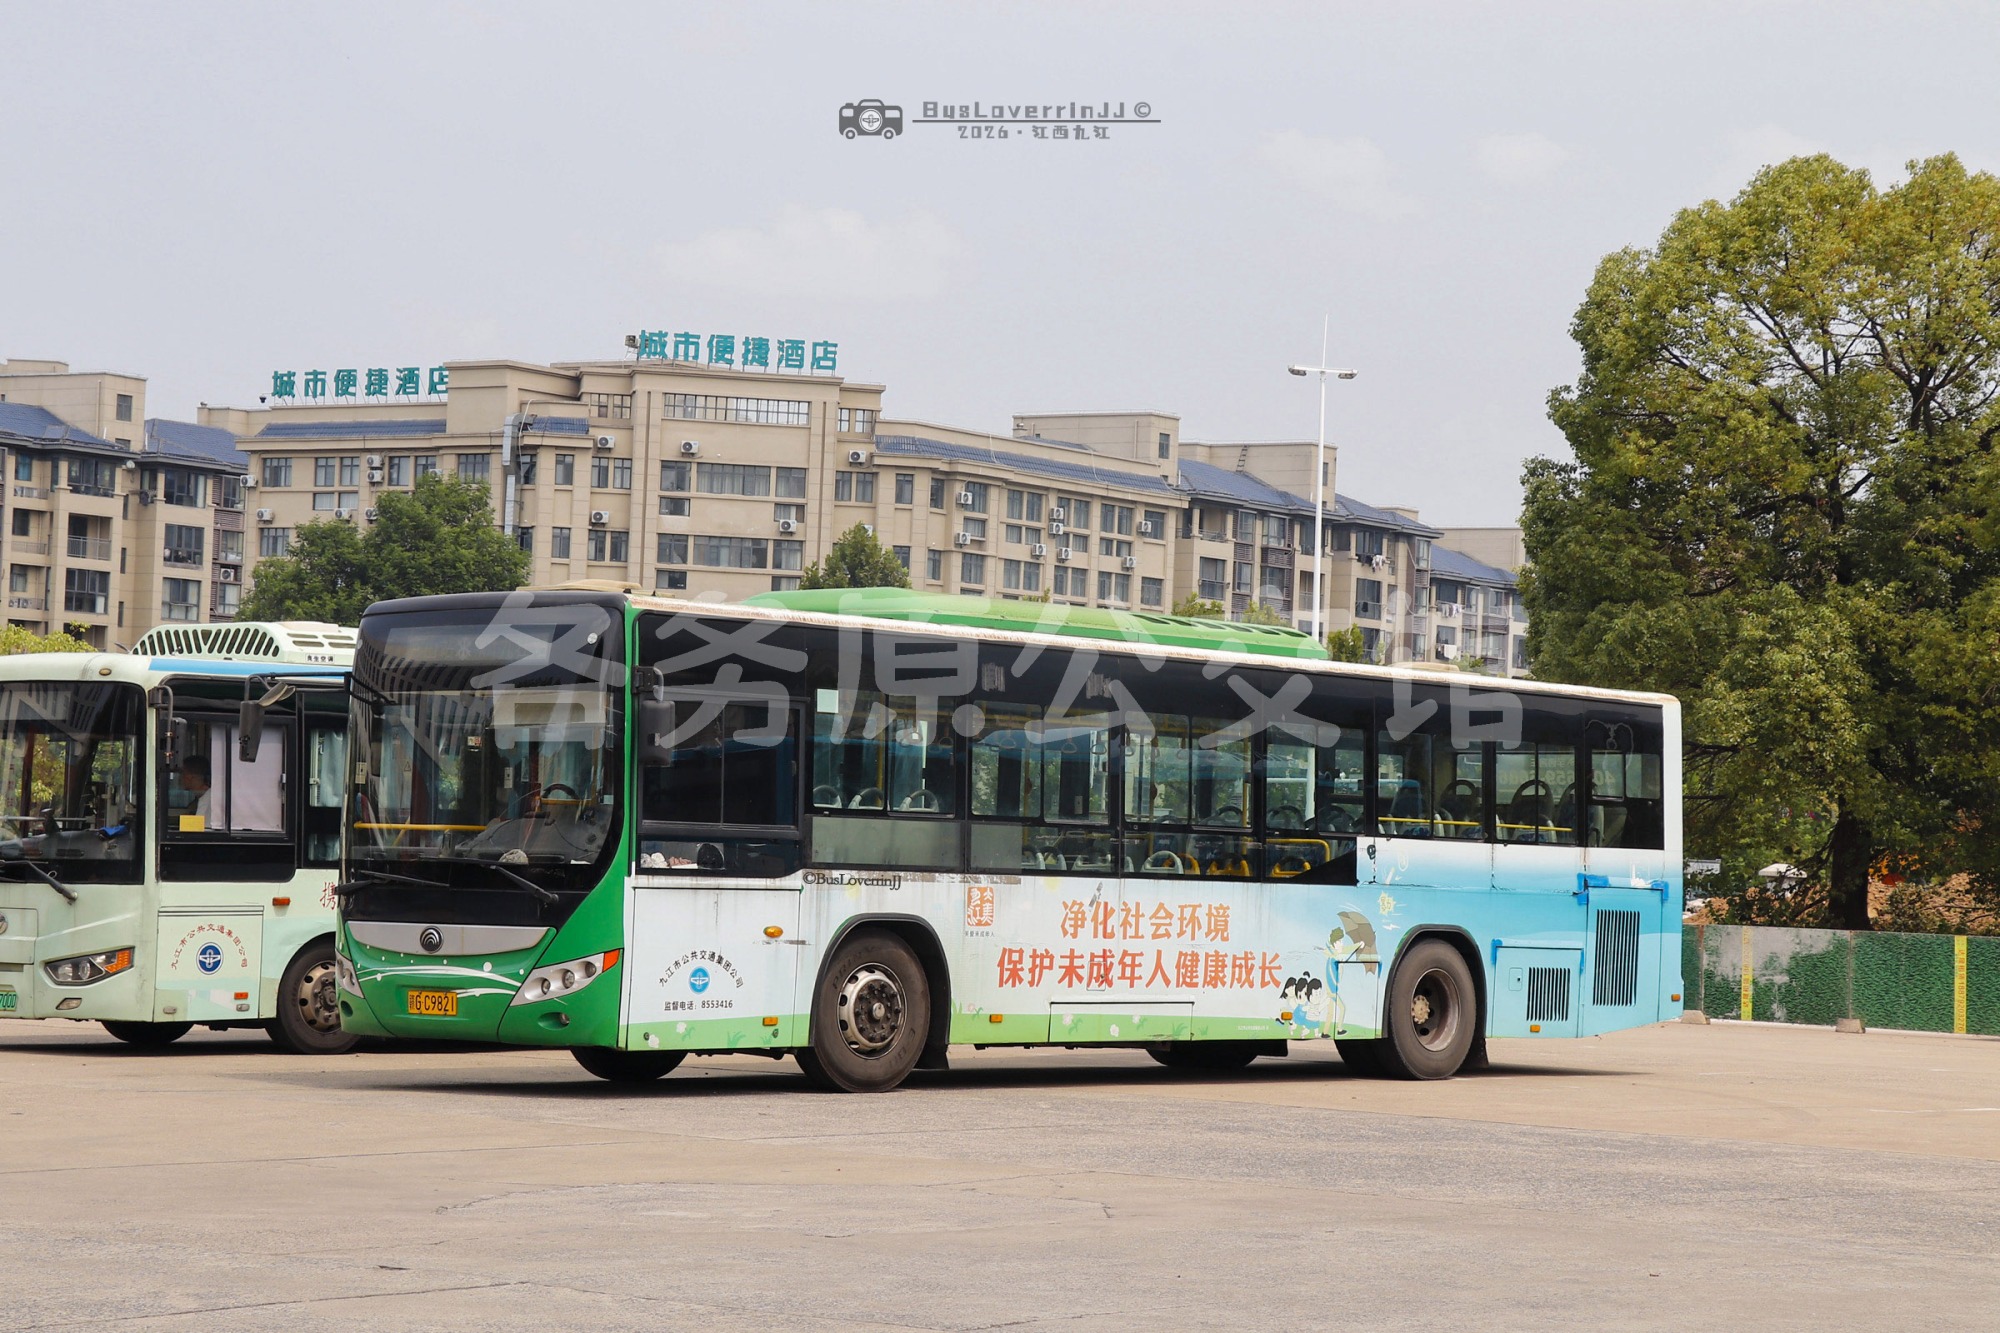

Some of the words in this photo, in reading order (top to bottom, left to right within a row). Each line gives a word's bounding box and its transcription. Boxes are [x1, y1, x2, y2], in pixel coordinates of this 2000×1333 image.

[639, 329, 839, 371] 城市便捷酒店
[271, 365, 448, 399] 城市便捷酒店
[1060, 899, 1231, 942] 净化社会环境
[170, 923, 248, 971] 九江市公共交通集团公司
[997, 947, 1283, 989] 保护未成年人健康成长
[659, 949, 744, 989] 九江市公共交通集团公司
